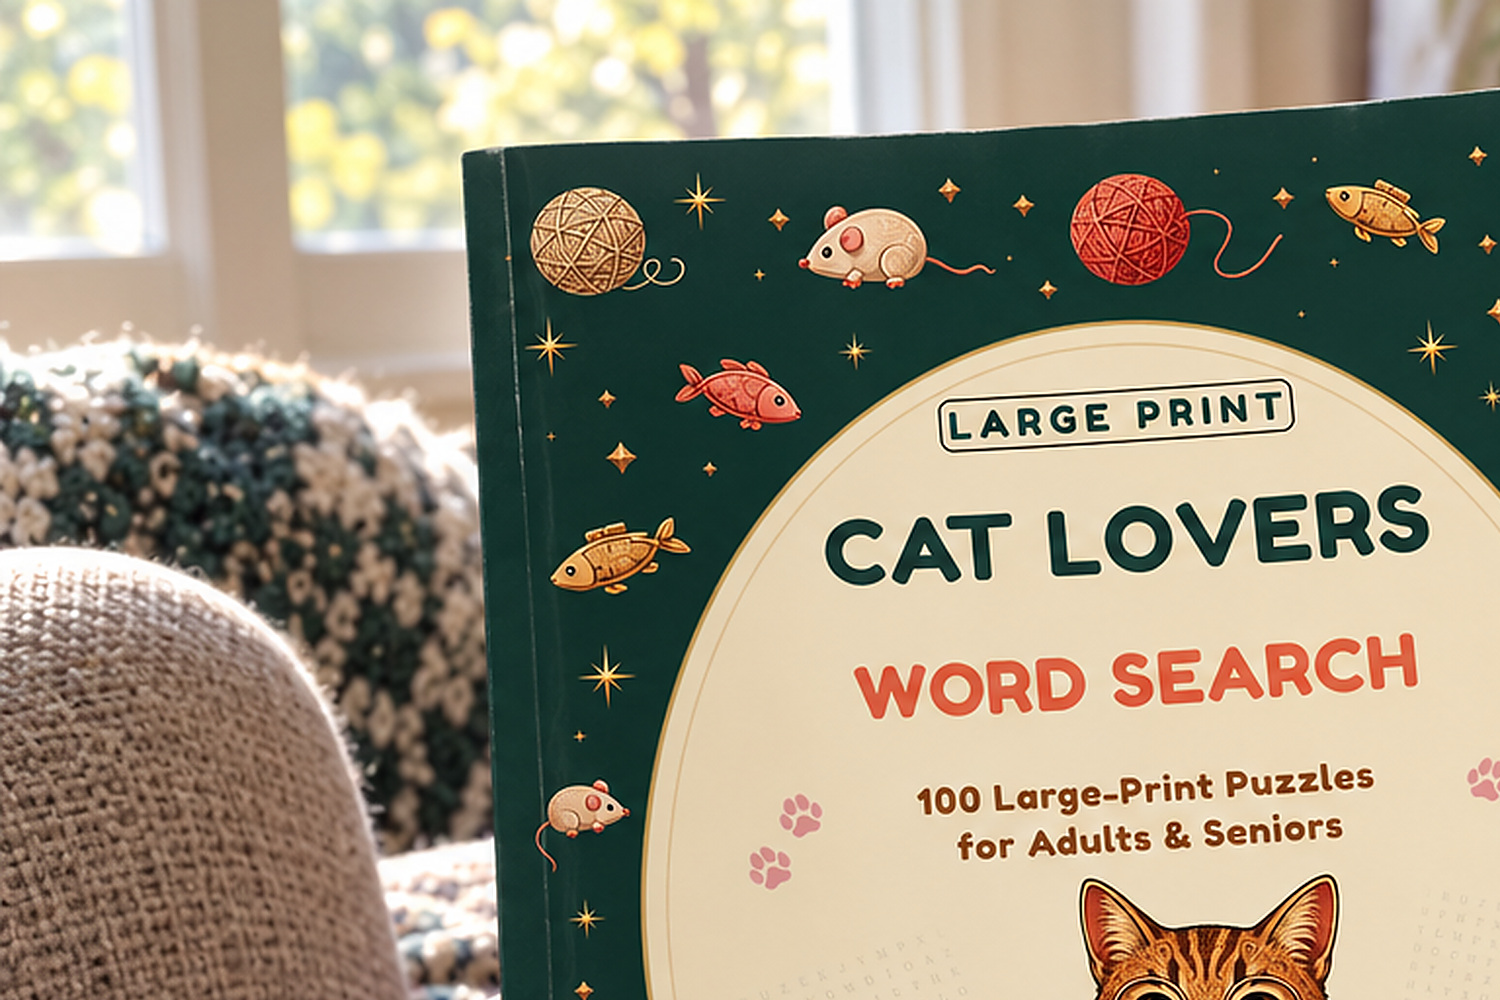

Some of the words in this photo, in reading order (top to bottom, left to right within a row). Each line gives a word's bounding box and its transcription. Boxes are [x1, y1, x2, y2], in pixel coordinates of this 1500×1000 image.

[949, 403, 1110, 440] LARGE
[1137, 391, 1283, 429] PRINT
[825, 513, 1012, 586] CAT
[1047, 485, 1429, 576] LOVERS
[854, 658, 1086, 719] WORD
[1112, 633, 1418, 707] SEARCH
[917, 786, 980, 815] 100
[994, 774, 1213, 816] Large-Print
[1226, 763, 1374, 798] Puzzles
[957, 832, 1014, 860] for
[1028, 825, 1151, 857] Adults
[1164, 821, 1191, 849] &
[1204, 814, 1343, 847] Seniors
